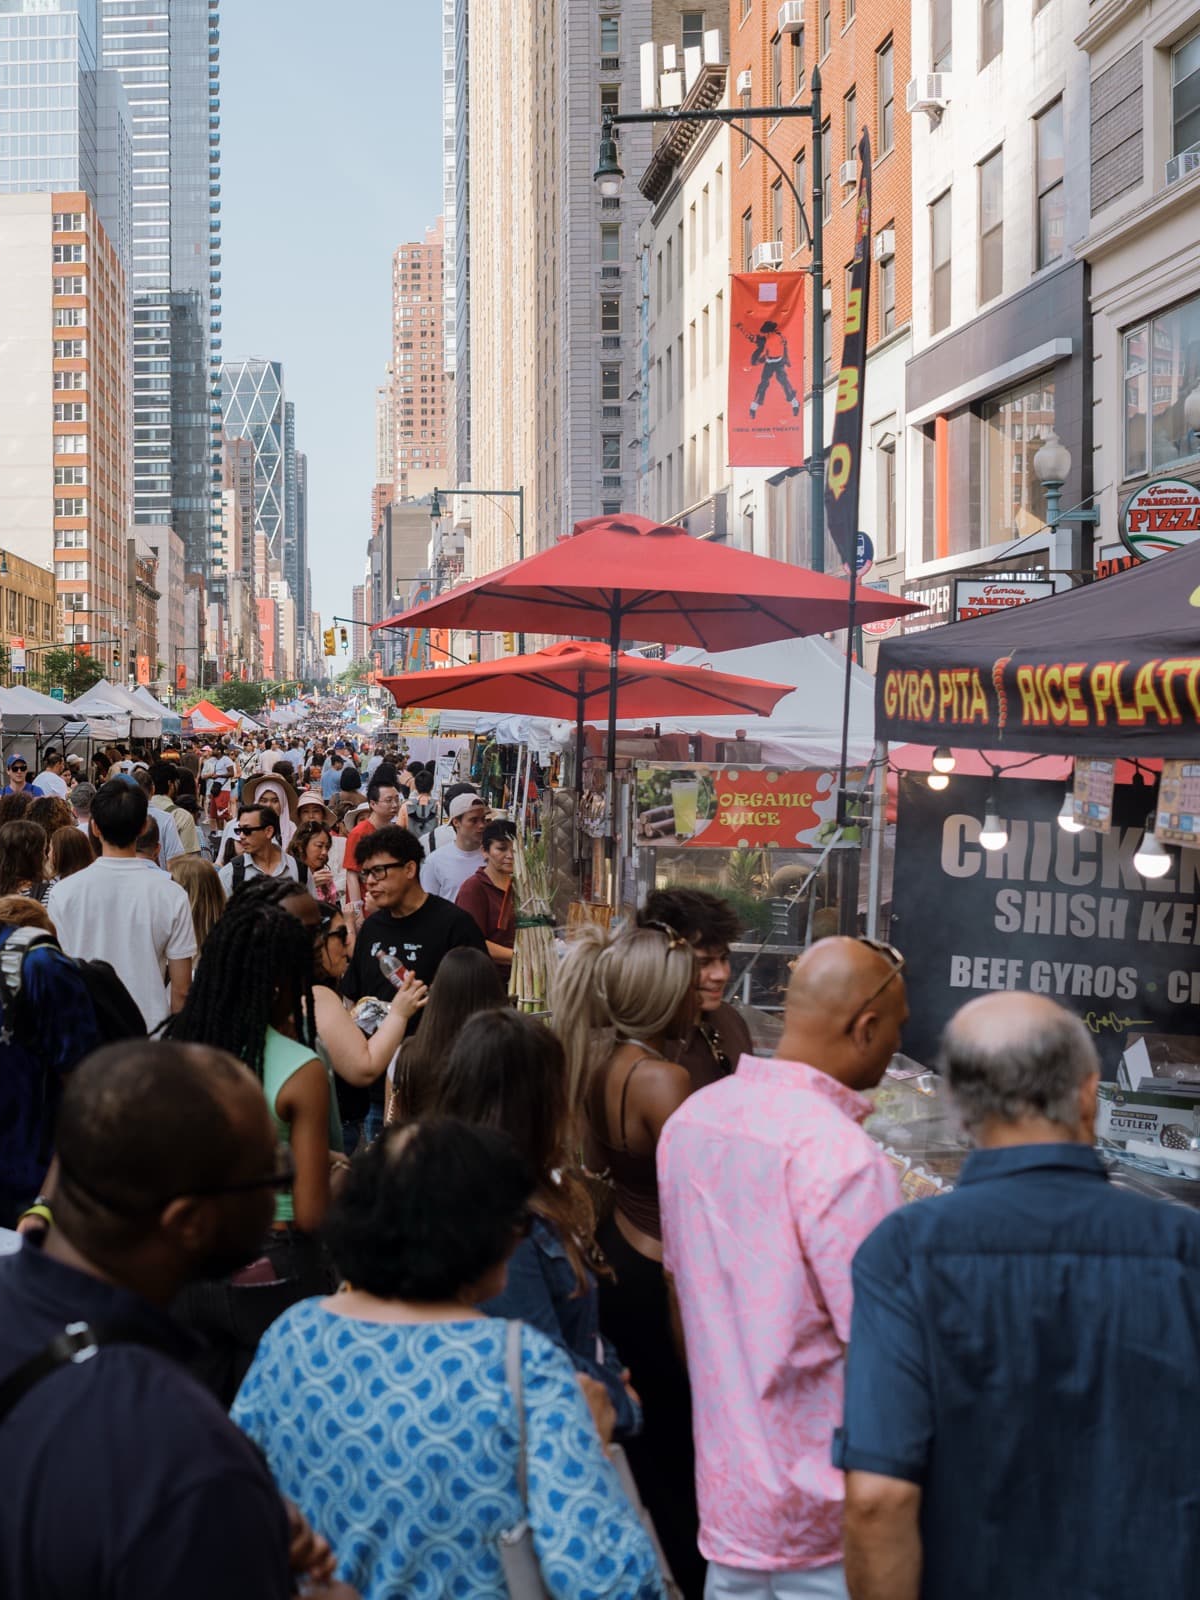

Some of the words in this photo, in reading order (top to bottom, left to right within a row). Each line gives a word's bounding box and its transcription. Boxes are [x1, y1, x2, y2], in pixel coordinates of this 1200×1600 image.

[983, 585, 1026, 595] Famous
[884, 669, 935, 722] GYRO
[938, 668, 989, 724] PITA
[1017, 662, 1088, 726] RICE
[1091, 656, 1200, 726] PLATT
[719, 793, 812, 807] ORGANIC
[719, 812, 780, 825] JUICE
[994, 889, 1129, 940] SHISH
[950, 955, 1024, 991] BEEF
[1029, 960, 1138, 1000] GYROS
[1110, 1119, 1158, 1130] CUTLERY
